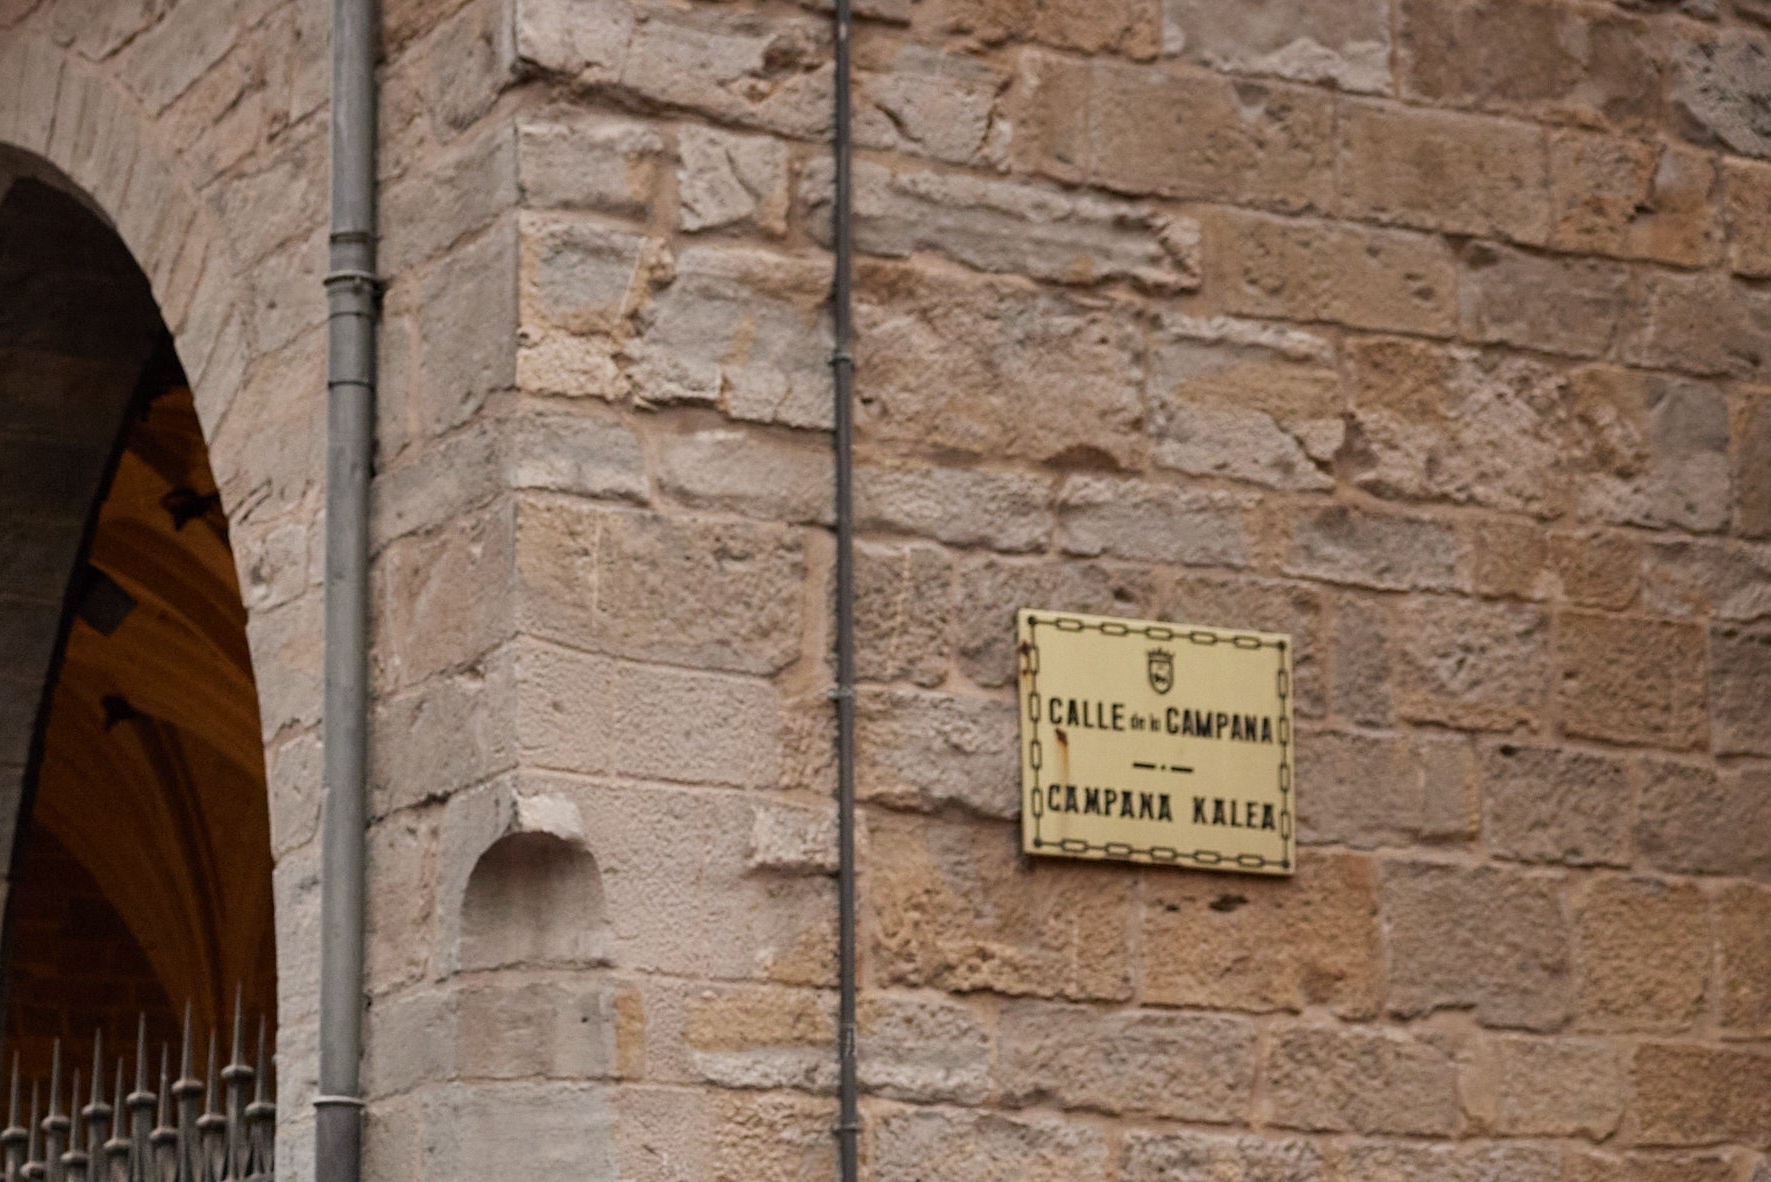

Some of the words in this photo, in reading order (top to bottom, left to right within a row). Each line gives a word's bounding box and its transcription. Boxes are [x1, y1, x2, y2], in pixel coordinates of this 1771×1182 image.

[1049, 697, 1125, 732] CALLE
[1130, 712, 1146, 731] de
[1166, 706, 1273, 743] CAMPANA
[1047, 783, 1173, 823] CAMPANA
[1193, 796, 1276, 831] KALEA
